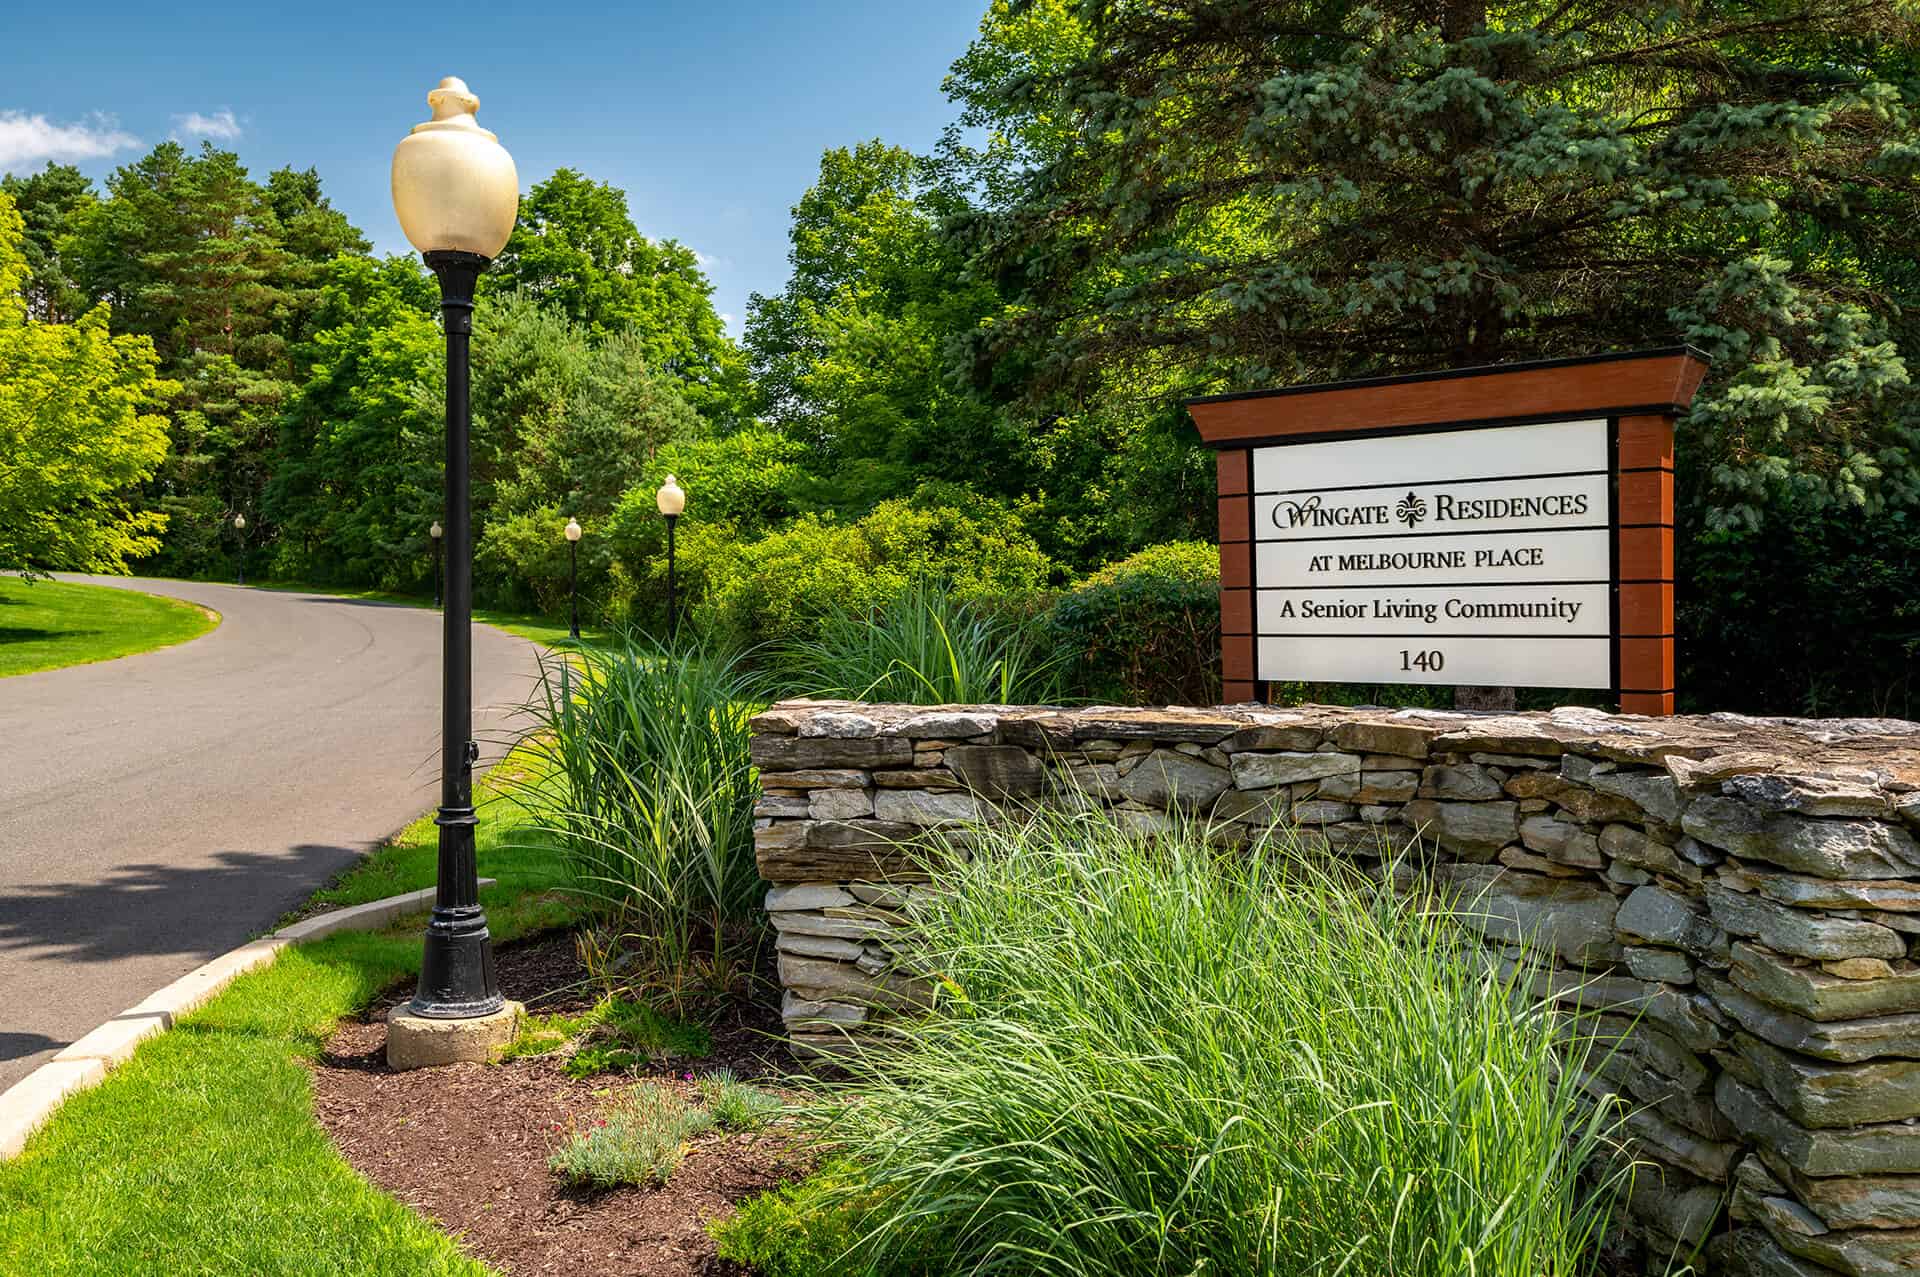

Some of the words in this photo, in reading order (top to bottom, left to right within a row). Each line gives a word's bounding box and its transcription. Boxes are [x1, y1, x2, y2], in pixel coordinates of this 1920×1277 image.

[1272, 495, 1389, 529] WINGATE
[1434, 493, 1588, 522] RESIDENCES
[1308, 555, 1334, 573] AT
[1338, 550, 1466, 572] MELBOURNE
[1473, 547, 1544, 568] PLACE
[1279, 599, 1297, 619] A
[1301, 598, 1368, 619] Senior
[1372, 598, 1438, 624] Living
[1444, 596, 1583, 624] Community
[1399, 650, 1445, 673] 140
